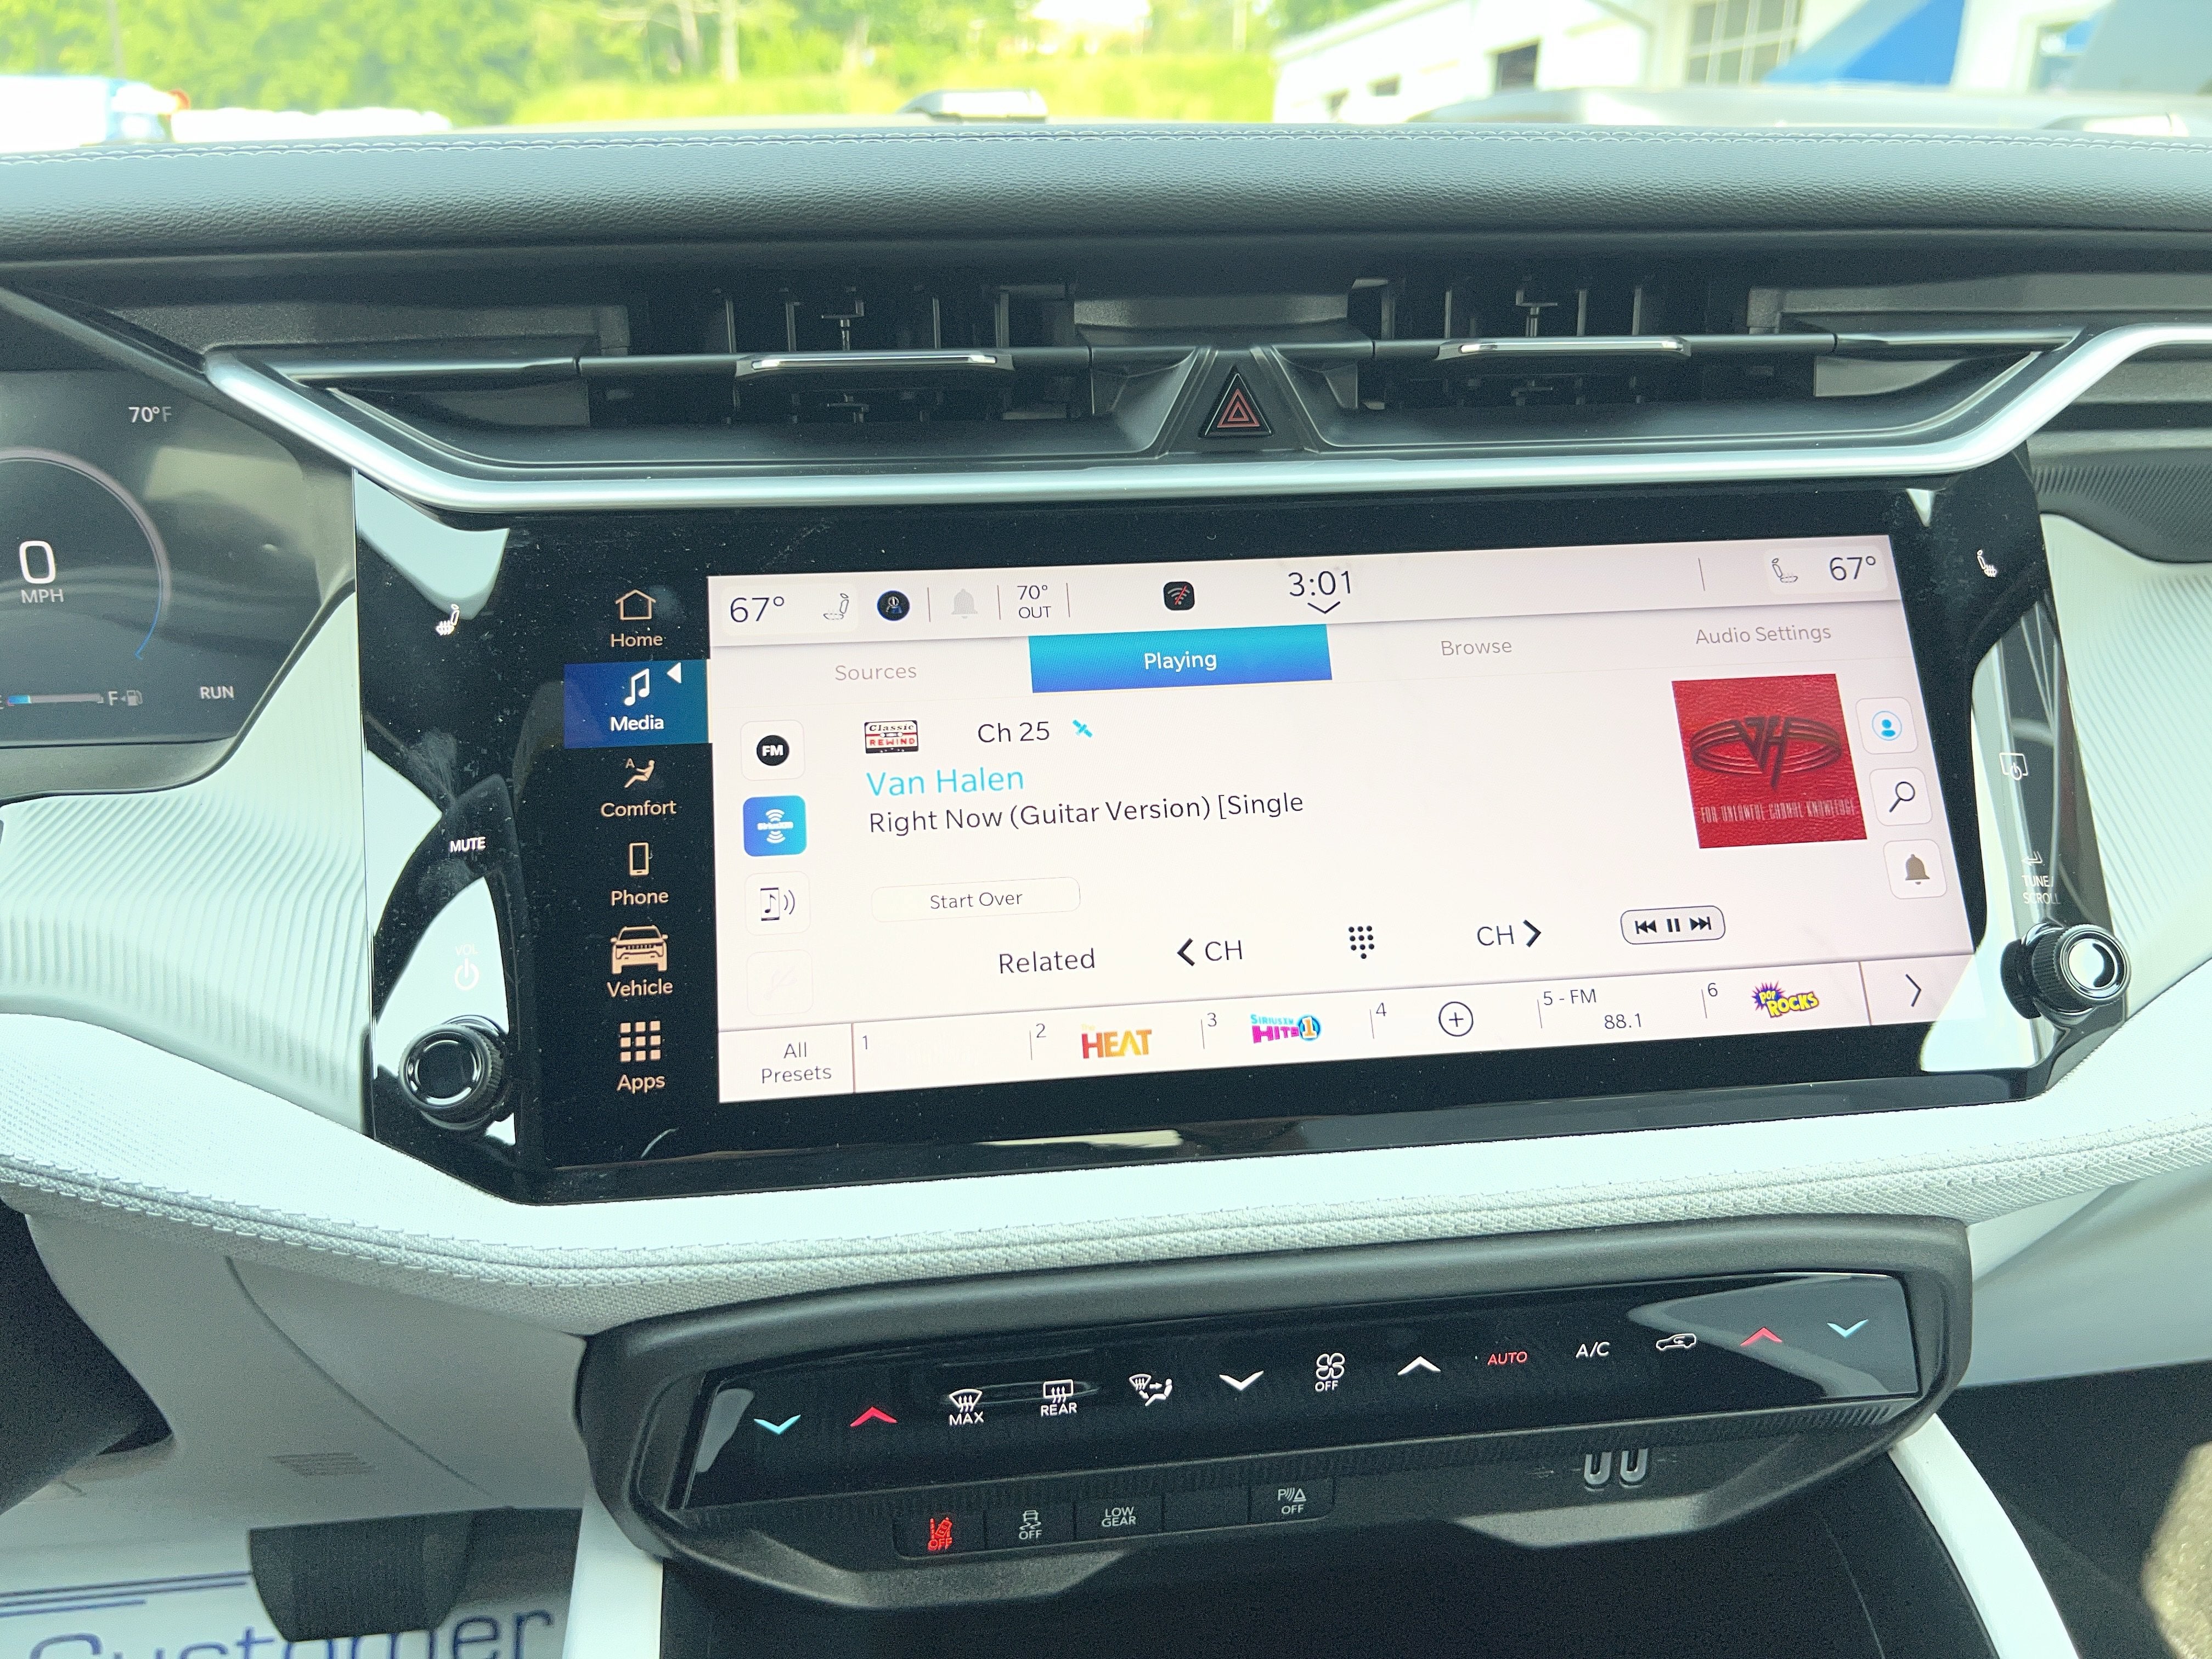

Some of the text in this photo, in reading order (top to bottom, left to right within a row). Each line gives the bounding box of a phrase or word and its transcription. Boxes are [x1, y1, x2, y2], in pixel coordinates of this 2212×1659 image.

[19, 540, 56, 584] 0
[1829, 556, 1876, 582] 67°
[1017, 584, 1048, 600] 70°
[1288, 570, 1352, 597] 3:01
[21, 589, 64, 603] MPH
[730, 596, 785, 623] 67°
[1018, 605, 1051, 619] OUT
[610, 631, 663, 648] Home
[1695, 625, 1832, 645] Audio Settings
[1441, 639, 1513, 656] Browse
[1144, 651, 1217, 672] Playing
[835, 664, 917, 682] Sources
[108, 691, 118, 706] F
[200, 686, 235, 699] RUN
[610, 714, 664, 731] Media
[977, 721, 1050, 744] Ch 25
[761, 744, 784, 757] FM
[870, 738, 915, 746] REWIND
[867, 766, 1024, 796] Van Halen
[600, 799, 677, 817] Comfort
[870, 792, 1304, 837] Right Now (Guitar Version) [Single
[1702, 805, 1718, 823] FOR
[449, 836, 487, 853] MUTE
[611, 889, 669, 906] Phone
[929, 891, 1023, 910] Start Over
[2022, 891, 2061, 905] SCROLL
[1476, 925, 1515, 947] CH
[455, 943, 479, 956] VOL
[1204, 940, 1243, 962] CH
[998, 948, 1096, 974] Related
[607, 979, 674, 998] Vehicle
[1707, 983, 1718, 997] 6
[1759, 990, 1776, 1004] POP
[1543, 991, 1553, 1006] 5
[1570, 989, 1597, 1005] FM
[1766, 992, 1819, 1017] ROCKS
[1375, 1002, 1387, 1018] 4
[1206, 1013, 1217, 1028] 3
[1604, 1013, 1642, 1030] 88.1
[1036, 1023, 1047, 1038] 2
[1252, 1016, 1317, 1043] HITS 1
[783, 1042, 808, 1059] All
[862, 1036, 868, 1050] 1
[1082, 1029, 1152, 1059] HEAT
[761, 1065, 832, 1084] Presets
[617, 1075, 665, 1094] Apps
[1487, 1352, 1527, 1365] AUTO
[1575, 1342, 1610, 1358] A/C
[1315, 1380, 1339, 1392] OFF
[949, 1411, 984, 1426] MAX
[1041, 1403, 1077, 1417] REAR
[1105, 1506, 1135, 1517] LOW
[1282, 1504, 1304, 1514] OFF
[1102, 1515, 1137, 1527] GEAR
[928, 1537, 952, 1550] OFF
[1018, 1530, 1042, 1541] OFF
